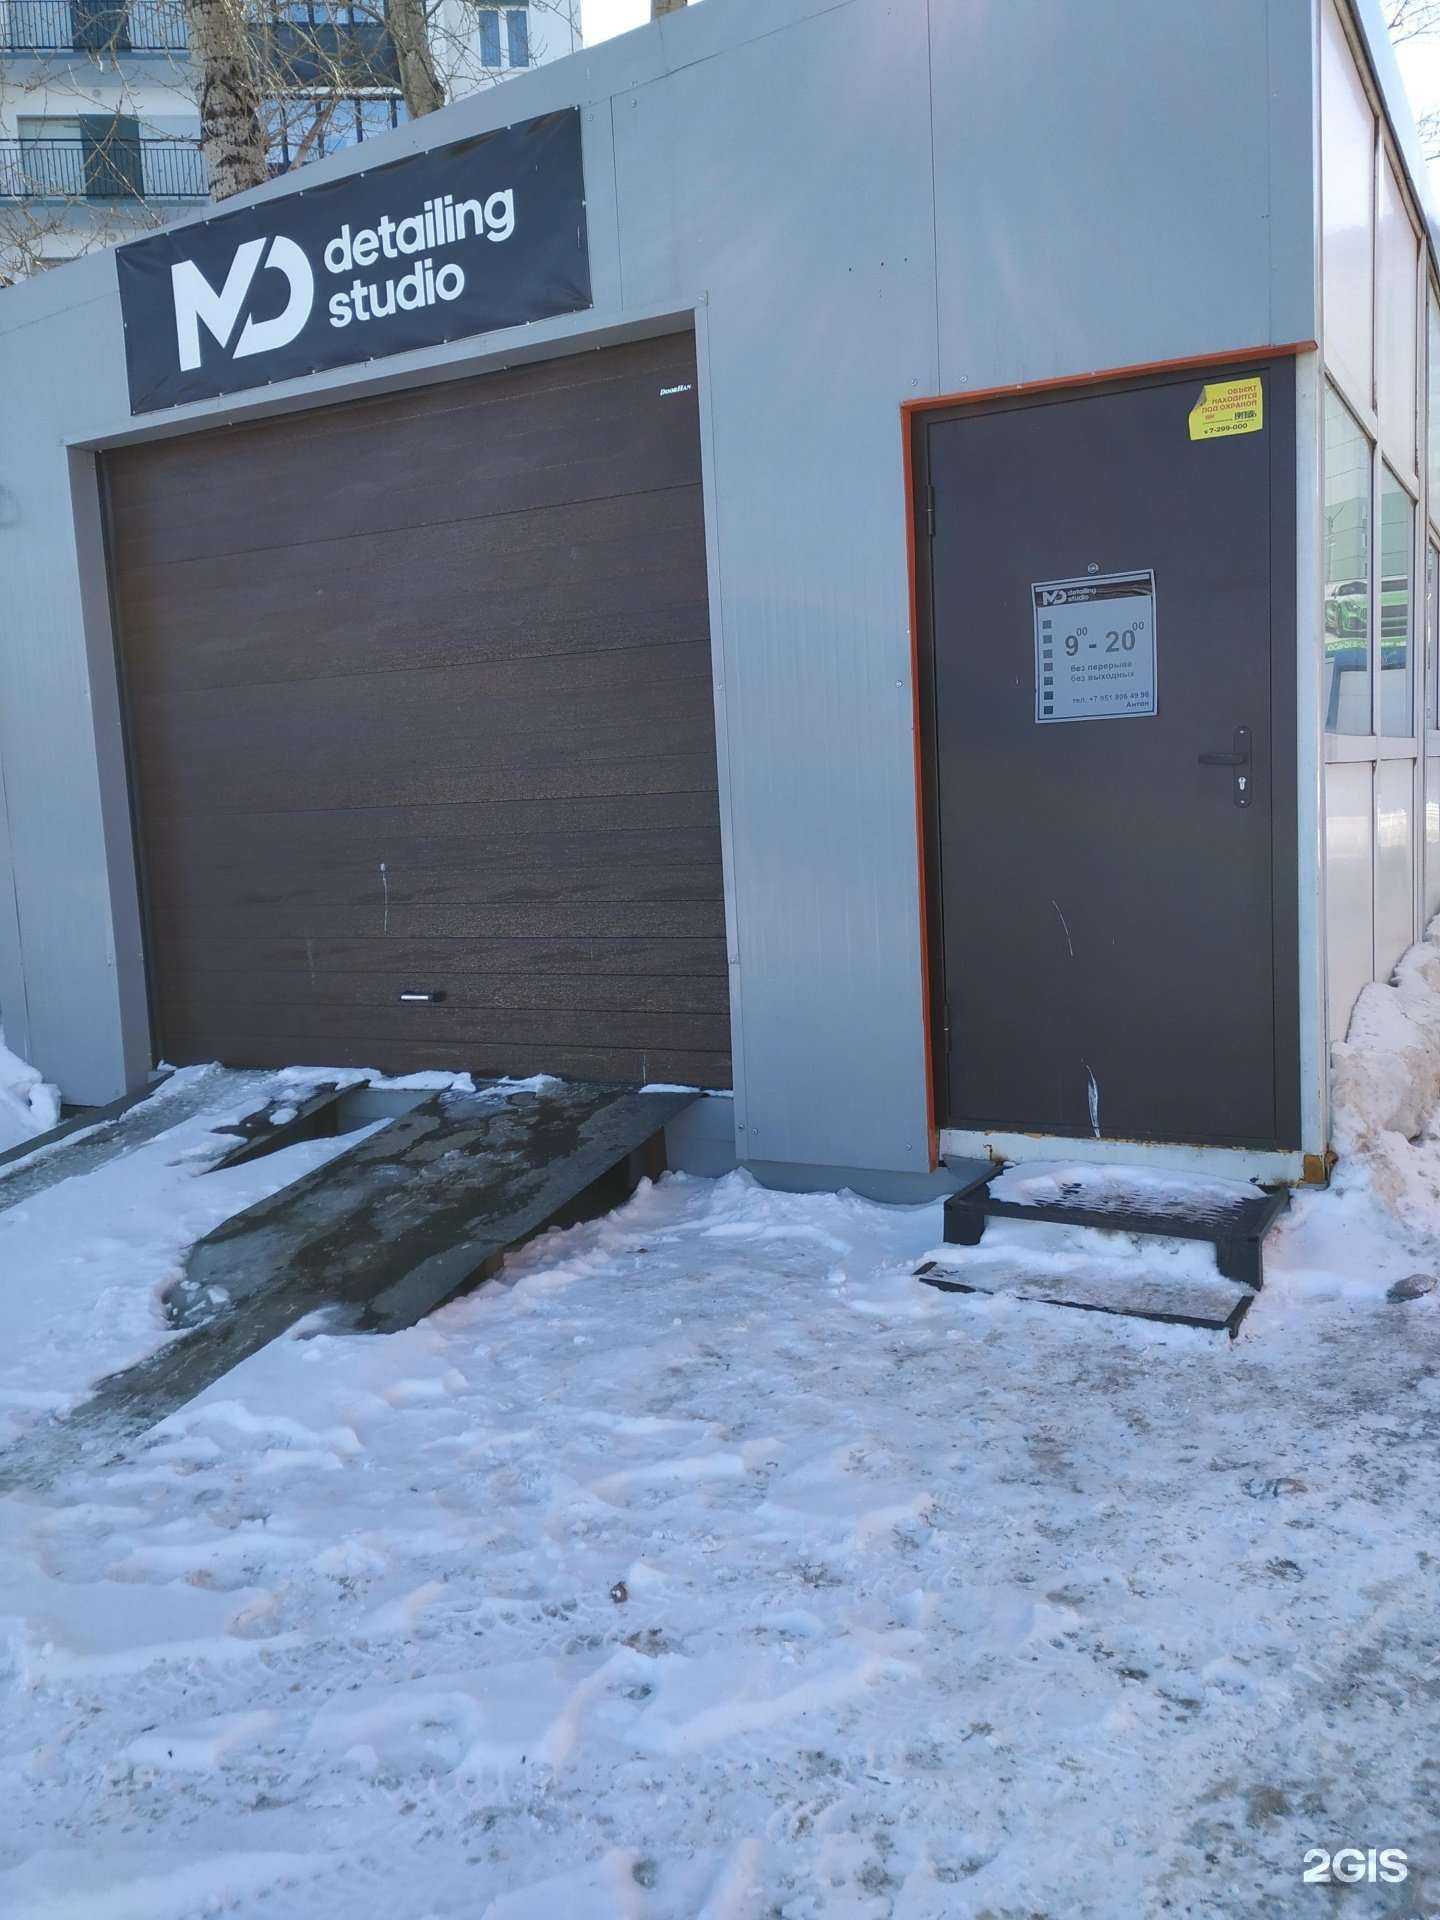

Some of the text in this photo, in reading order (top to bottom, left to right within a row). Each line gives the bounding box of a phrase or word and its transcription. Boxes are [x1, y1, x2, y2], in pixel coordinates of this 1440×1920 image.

[324, 187, 515, 275] detailing
[328, 262, 465, 328] studio
[171, 235, 314, 371] MD
[1212, 392, 1257, 404] НАХОДИТСЯ
[1201, 399, 1257, 414] ПОД ОХРАНОЙ
[1070, 661, 1132, 672] без перерыва
[1070, 671, 1134, 682] без выходных
[1126, 700, 1149, 708] Антон
